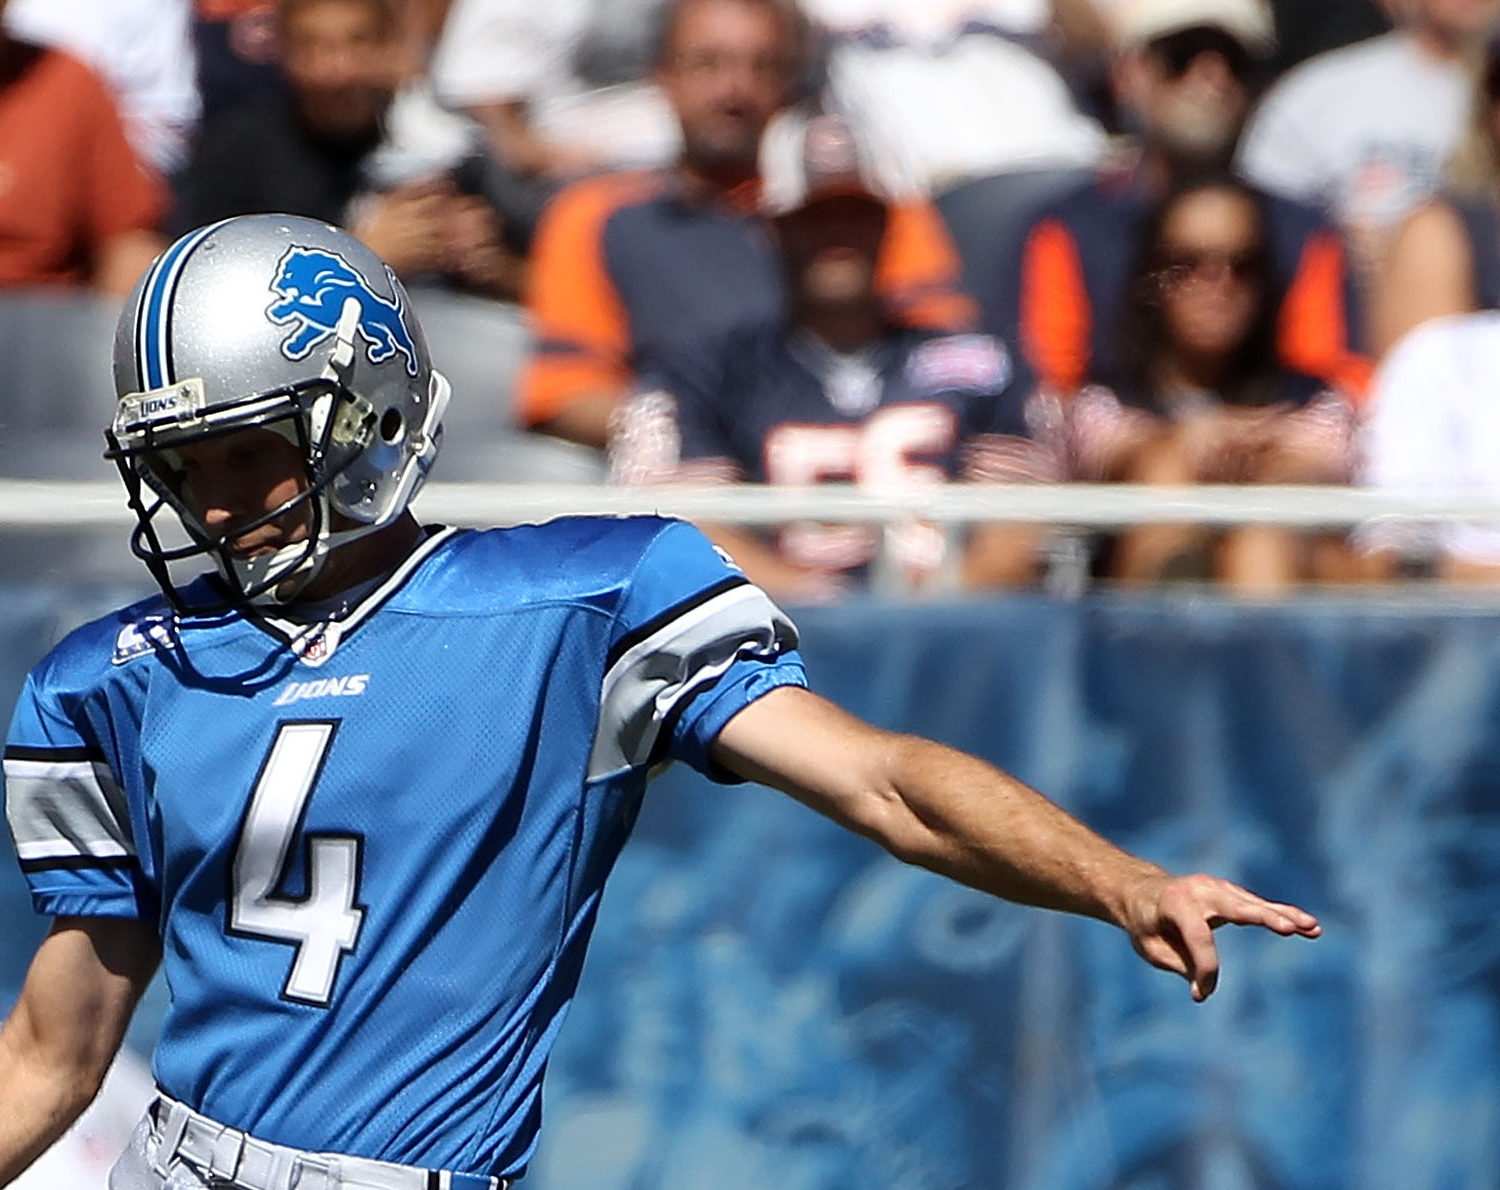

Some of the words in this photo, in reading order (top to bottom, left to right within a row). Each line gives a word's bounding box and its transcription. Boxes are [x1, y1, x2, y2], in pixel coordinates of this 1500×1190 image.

[141, 397, 178, 418] LIONS
[271, 673, 370, 706] LIONS
[224, 717, 368, 1009] 4
